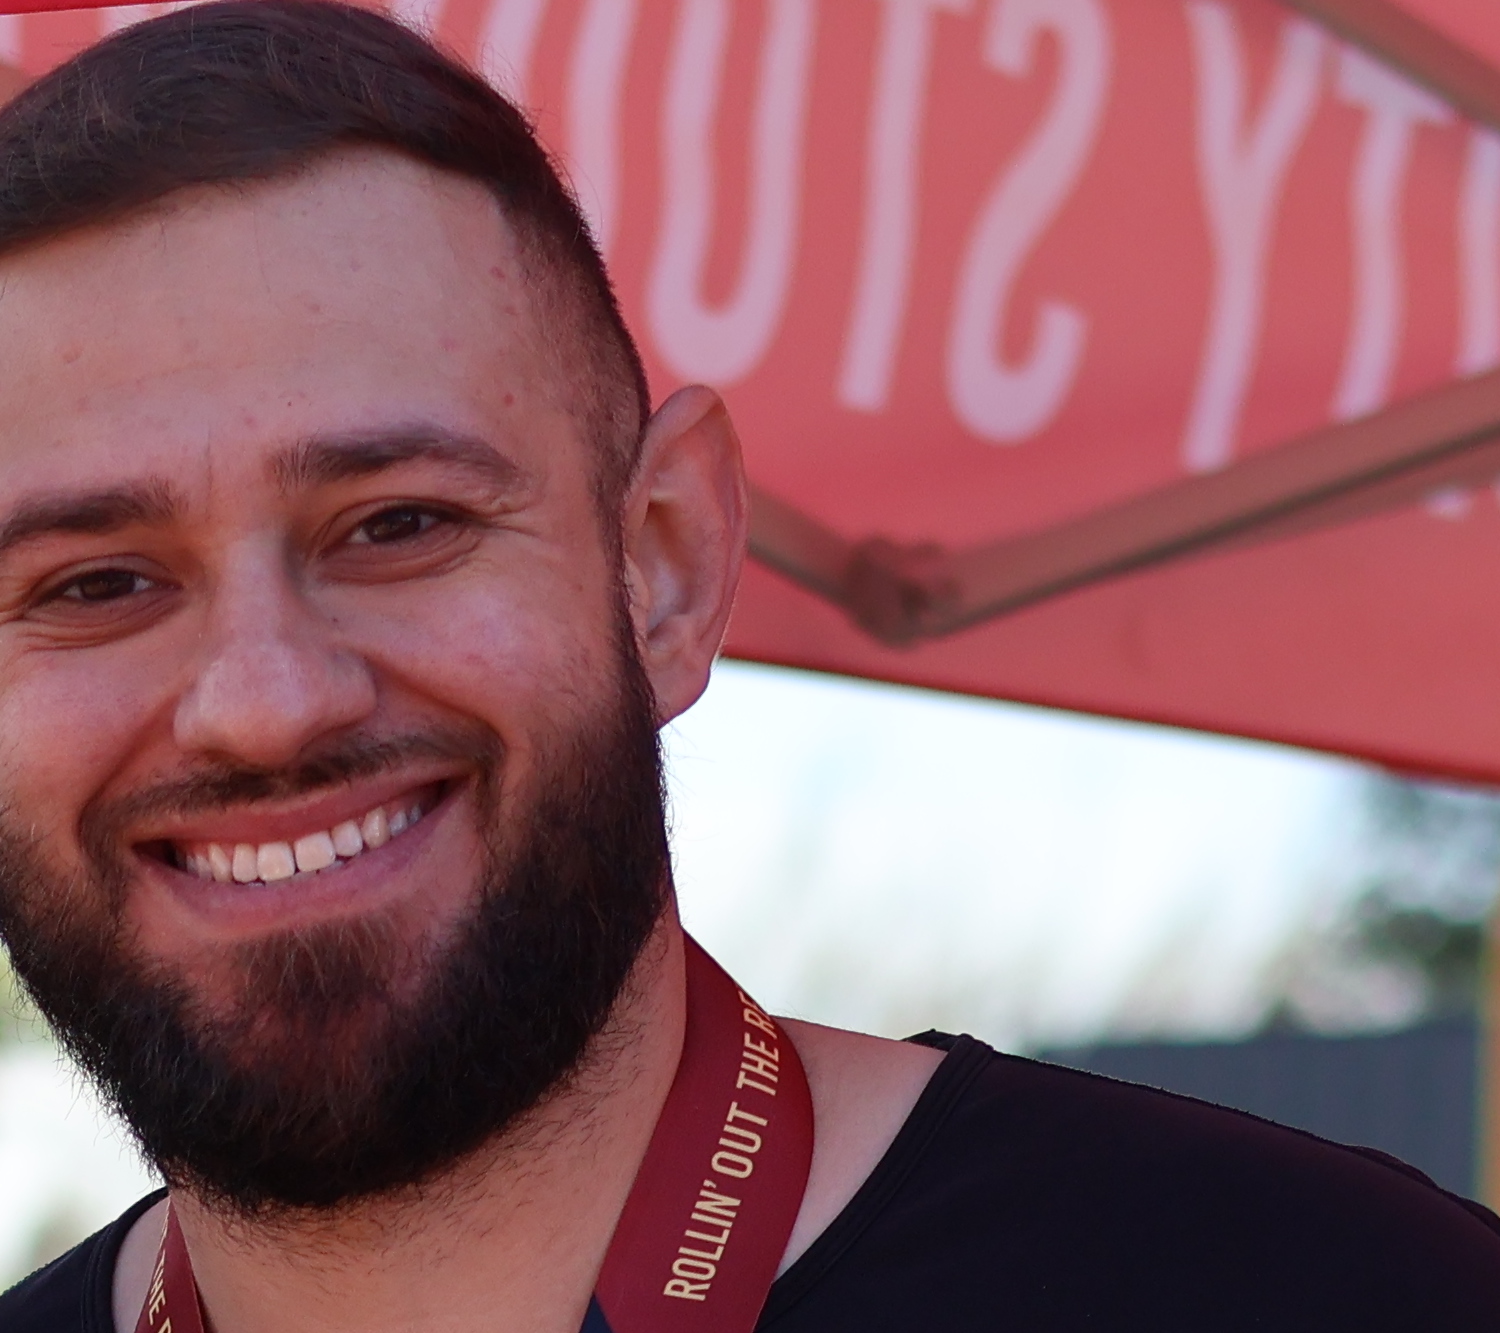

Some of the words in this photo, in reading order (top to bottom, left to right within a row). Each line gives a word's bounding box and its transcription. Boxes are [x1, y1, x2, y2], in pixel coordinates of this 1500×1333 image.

[736, 1032, 780, 1096] THE
[711, 1101, 769, 1179] OUT
[663, 1179, 742, 1302] ROLLIN'
